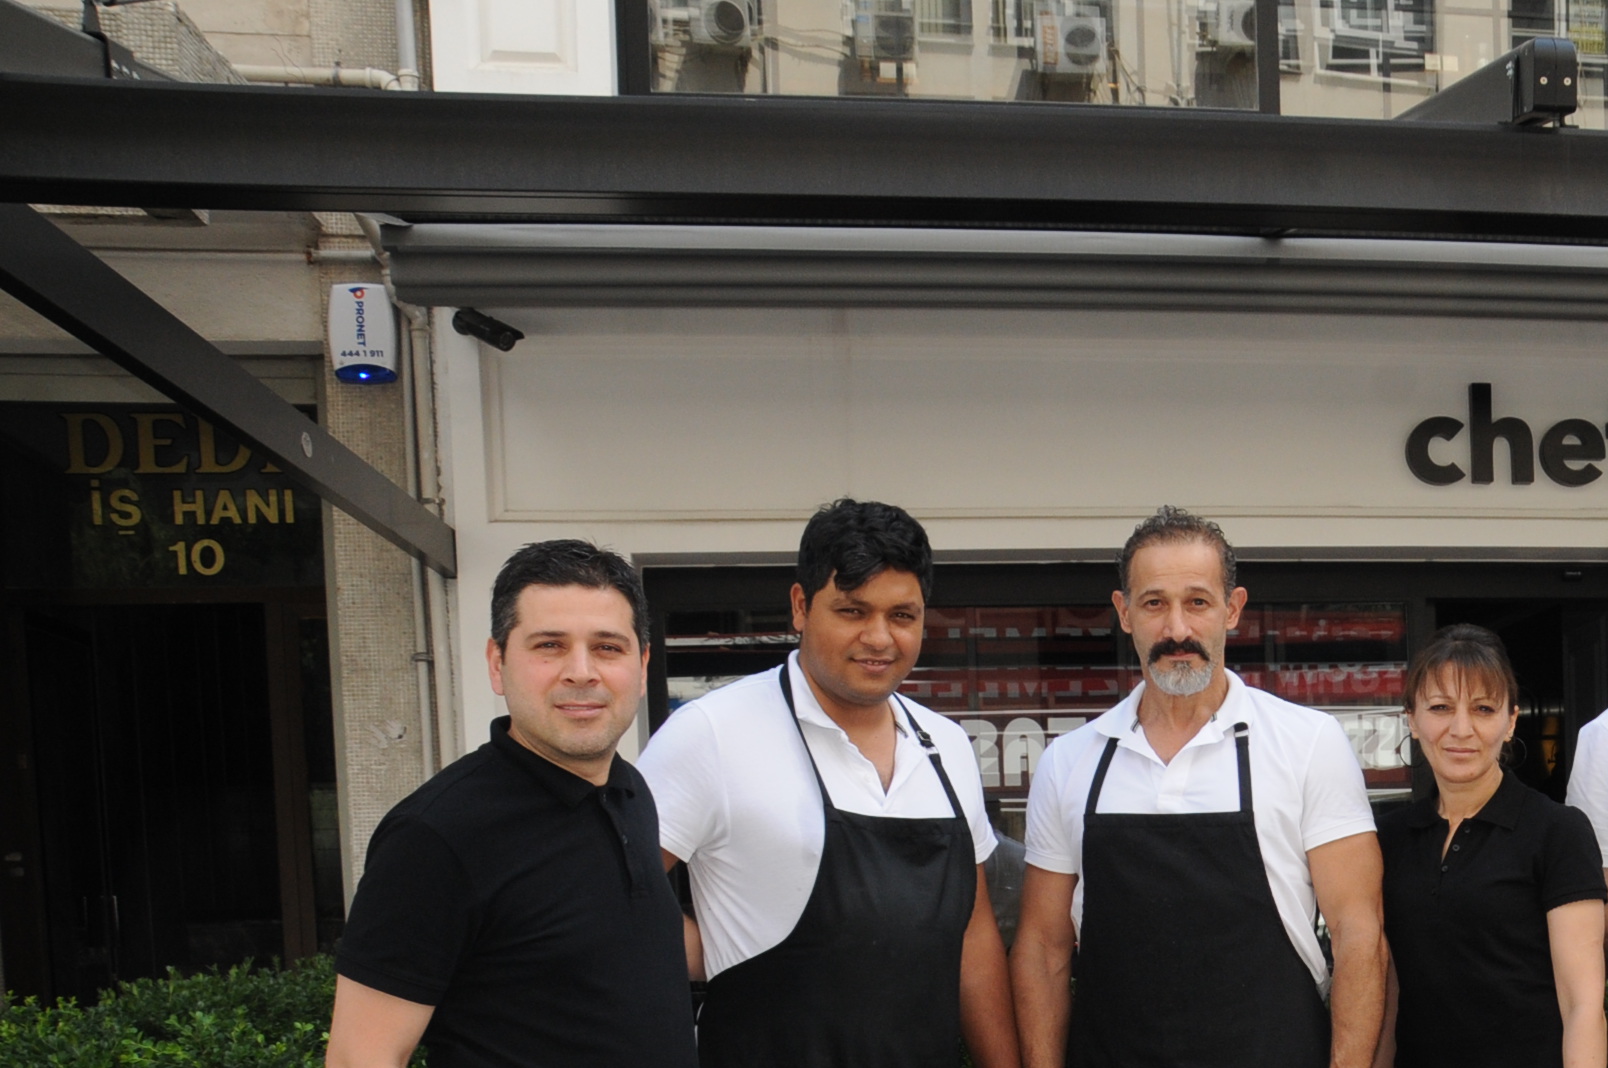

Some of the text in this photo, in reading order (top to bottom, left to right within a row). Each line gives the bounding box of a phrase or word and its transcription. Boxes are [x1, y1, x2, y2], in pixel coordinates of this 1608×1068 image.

[355, 301, 366, 347] PRONET
[58, 412, 283, 474] DED
[172, 489, 295, 525] HANI
[169, 539, 225, 576] 10
